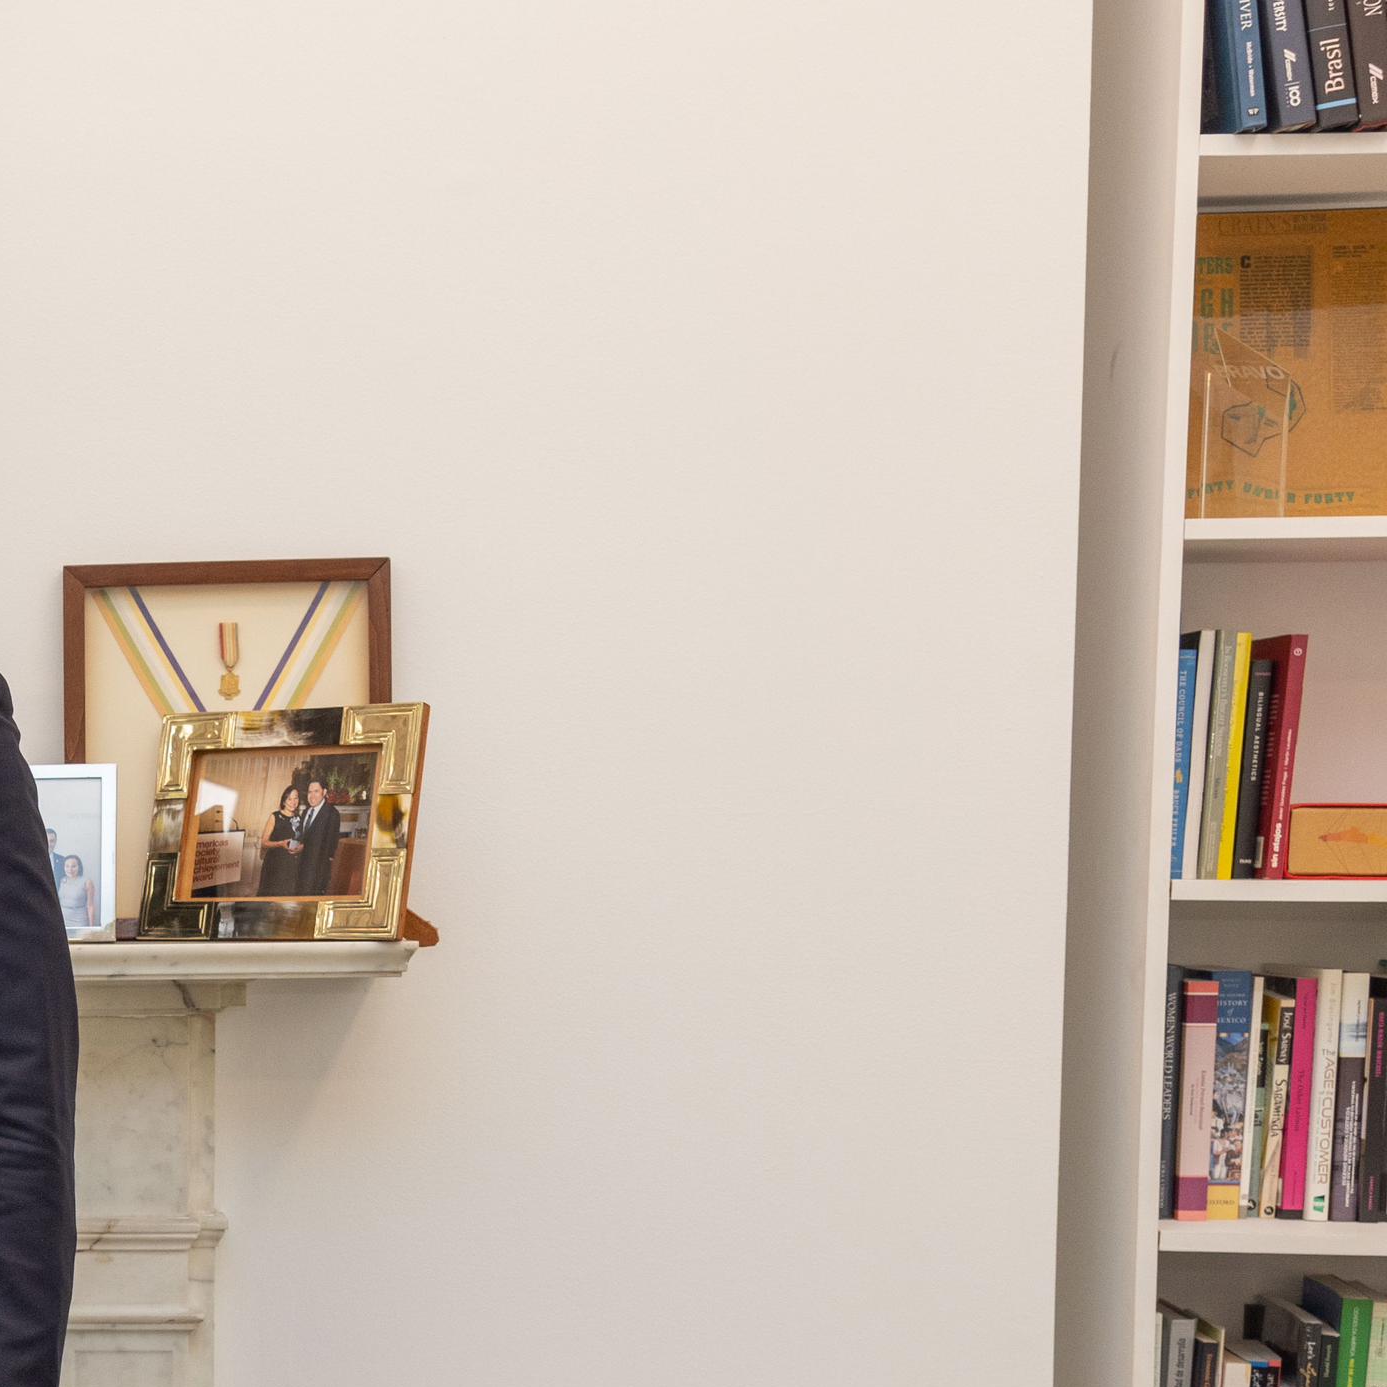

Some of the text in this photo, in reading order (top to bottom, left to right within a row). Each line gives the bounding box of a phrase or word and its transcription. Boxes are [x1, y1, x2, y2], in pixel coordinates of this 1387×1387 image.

[1320, 38, 1345, 94] Brasil
[1288, 85, 1301, 107] 100
[1178, 670, 1187, 686] THE
[1177, 688, 1187, 726] COUNCIL
[1250, 692, 1264, 782] BILINGUAL AESTHETICS
[1271, 822, 1283, 868] sin atajos
[1163, 992, 1177, 1120] WOMEN WORLD LEADERS
[1317, 1057, 1336, 1185] AGE CUSTOMER
[1177, 1338, 1187, 1367] desarrollo
